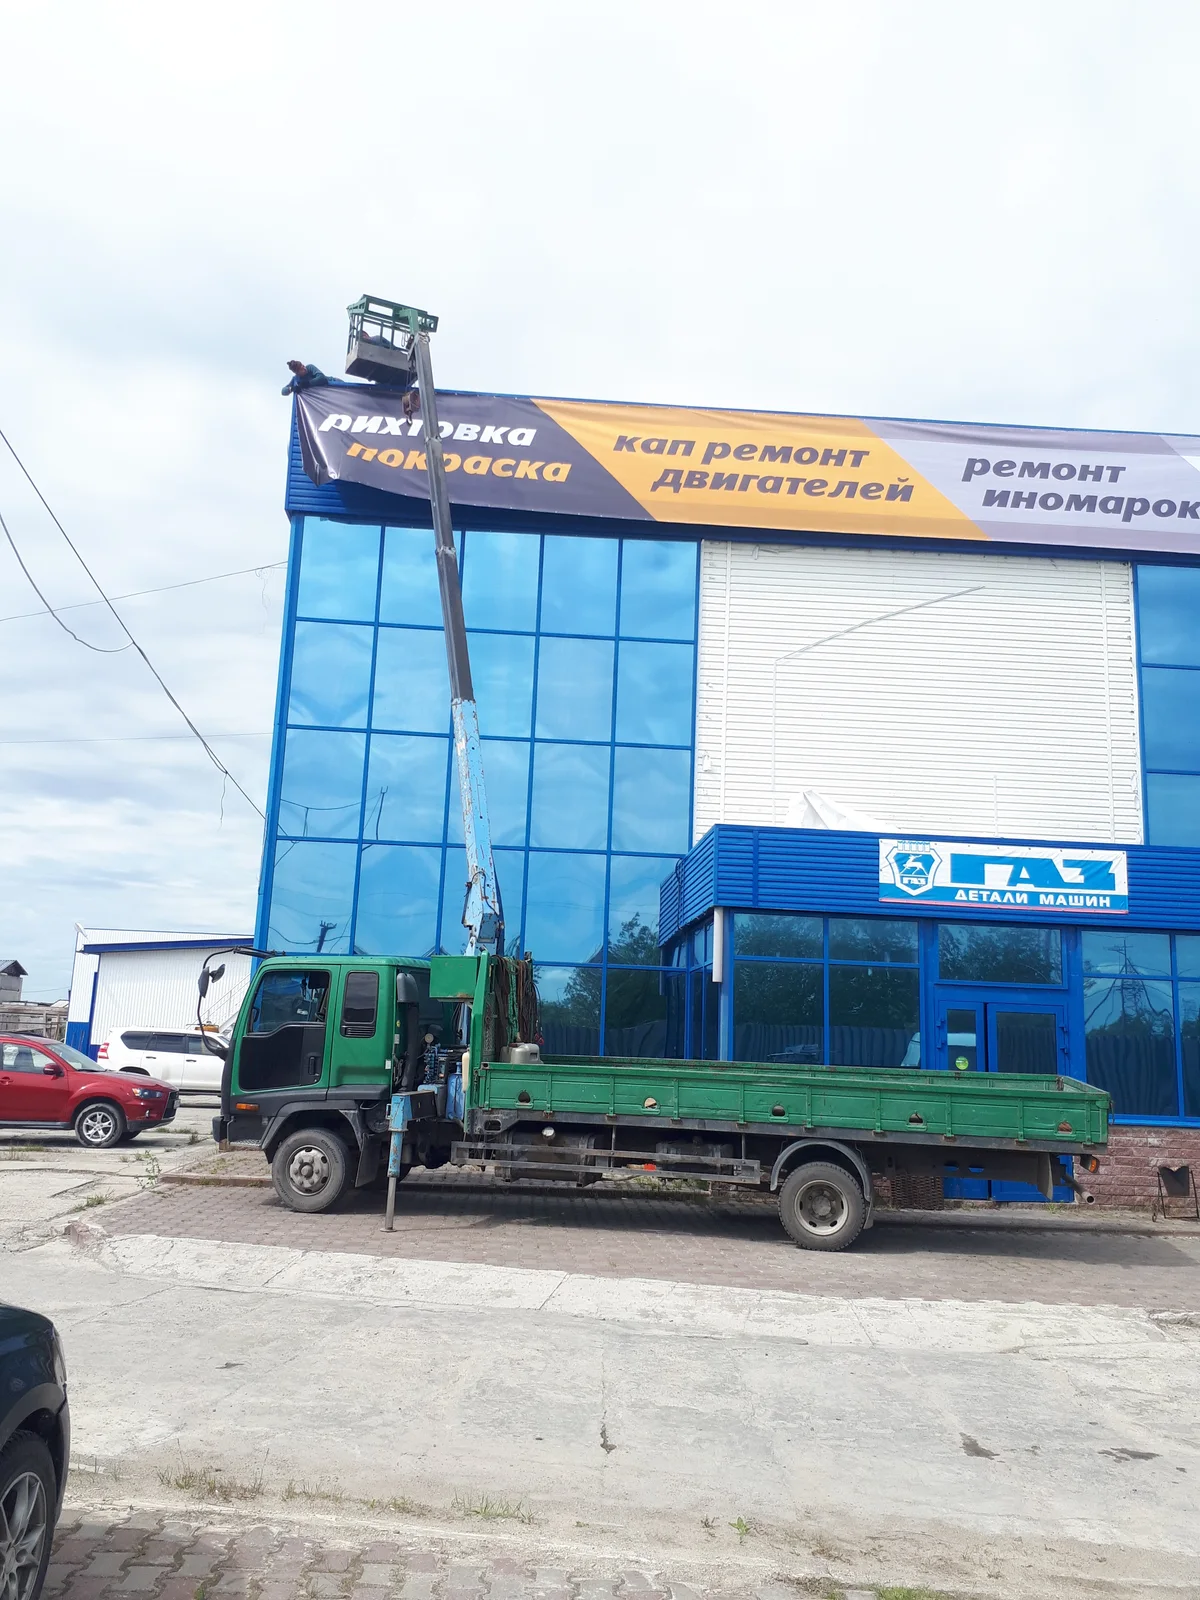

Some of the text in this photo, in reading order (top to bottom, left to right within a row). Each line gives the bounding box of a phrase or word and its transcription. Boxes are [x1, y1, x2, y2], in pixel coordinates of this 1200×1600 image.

[613, 435, 870, 468] кап ремонт
[650, 468, 915, 502] двигателей
[961, 457, 1126, 483] ремонт
[982, 489, 1200, 522] иномарок
[950, 853, 1116, 891] ГАЗ
[955, 889, 1110, 908] ДЕТАЛИ МАШИН
